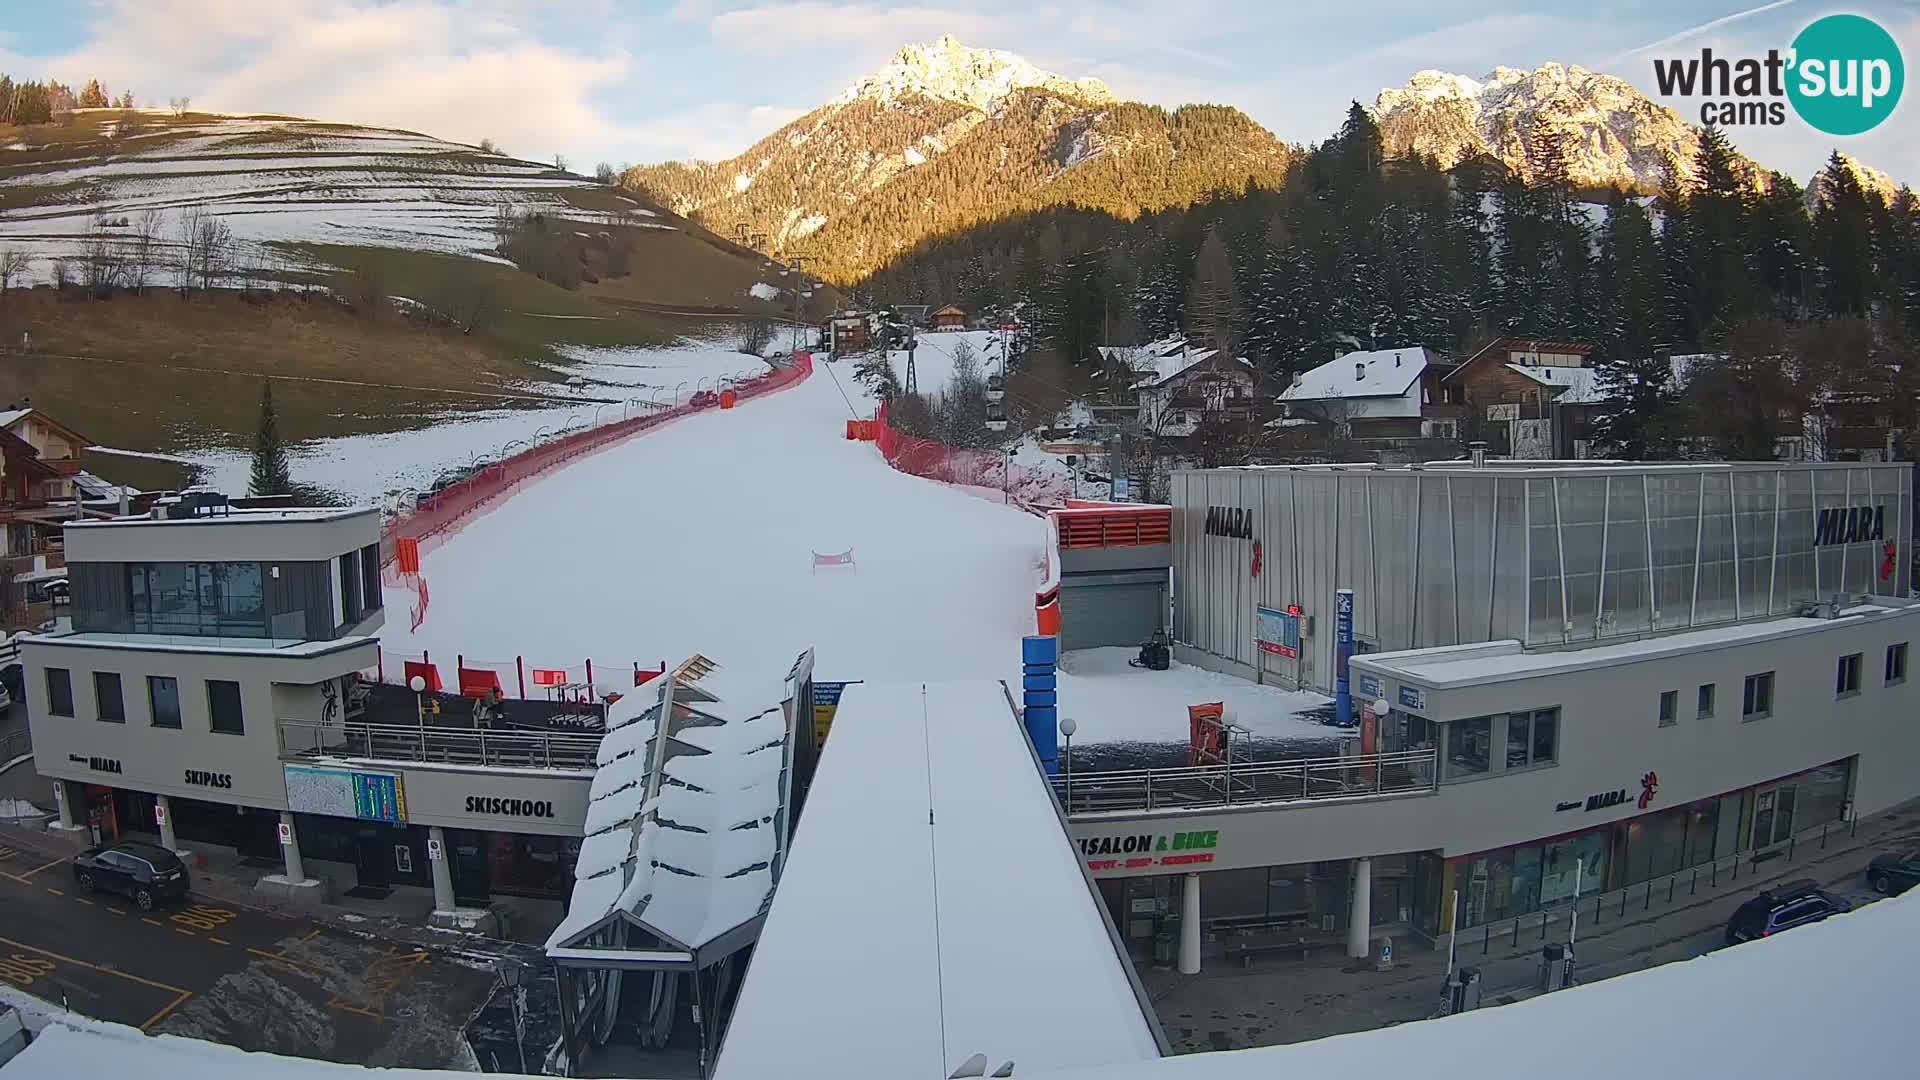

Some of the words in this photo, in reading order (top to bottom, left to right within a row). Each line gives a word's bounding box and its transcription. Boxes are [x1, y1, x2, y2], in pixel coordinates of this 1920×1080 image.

[1205, 505, 1253, 540] MIARA
[1813, 505, 1884, 546] MIARA
[90, 757, 122, 774] MIARA
[184, 769, 232, 788] SKIPASS
[465, 796, 555, 818] SKISCHOOL
[1584, 789, 1626, 812] MIARA
[1172, 831, 1217, 850] BIKE
[169, 904, 237, 930] BUS
